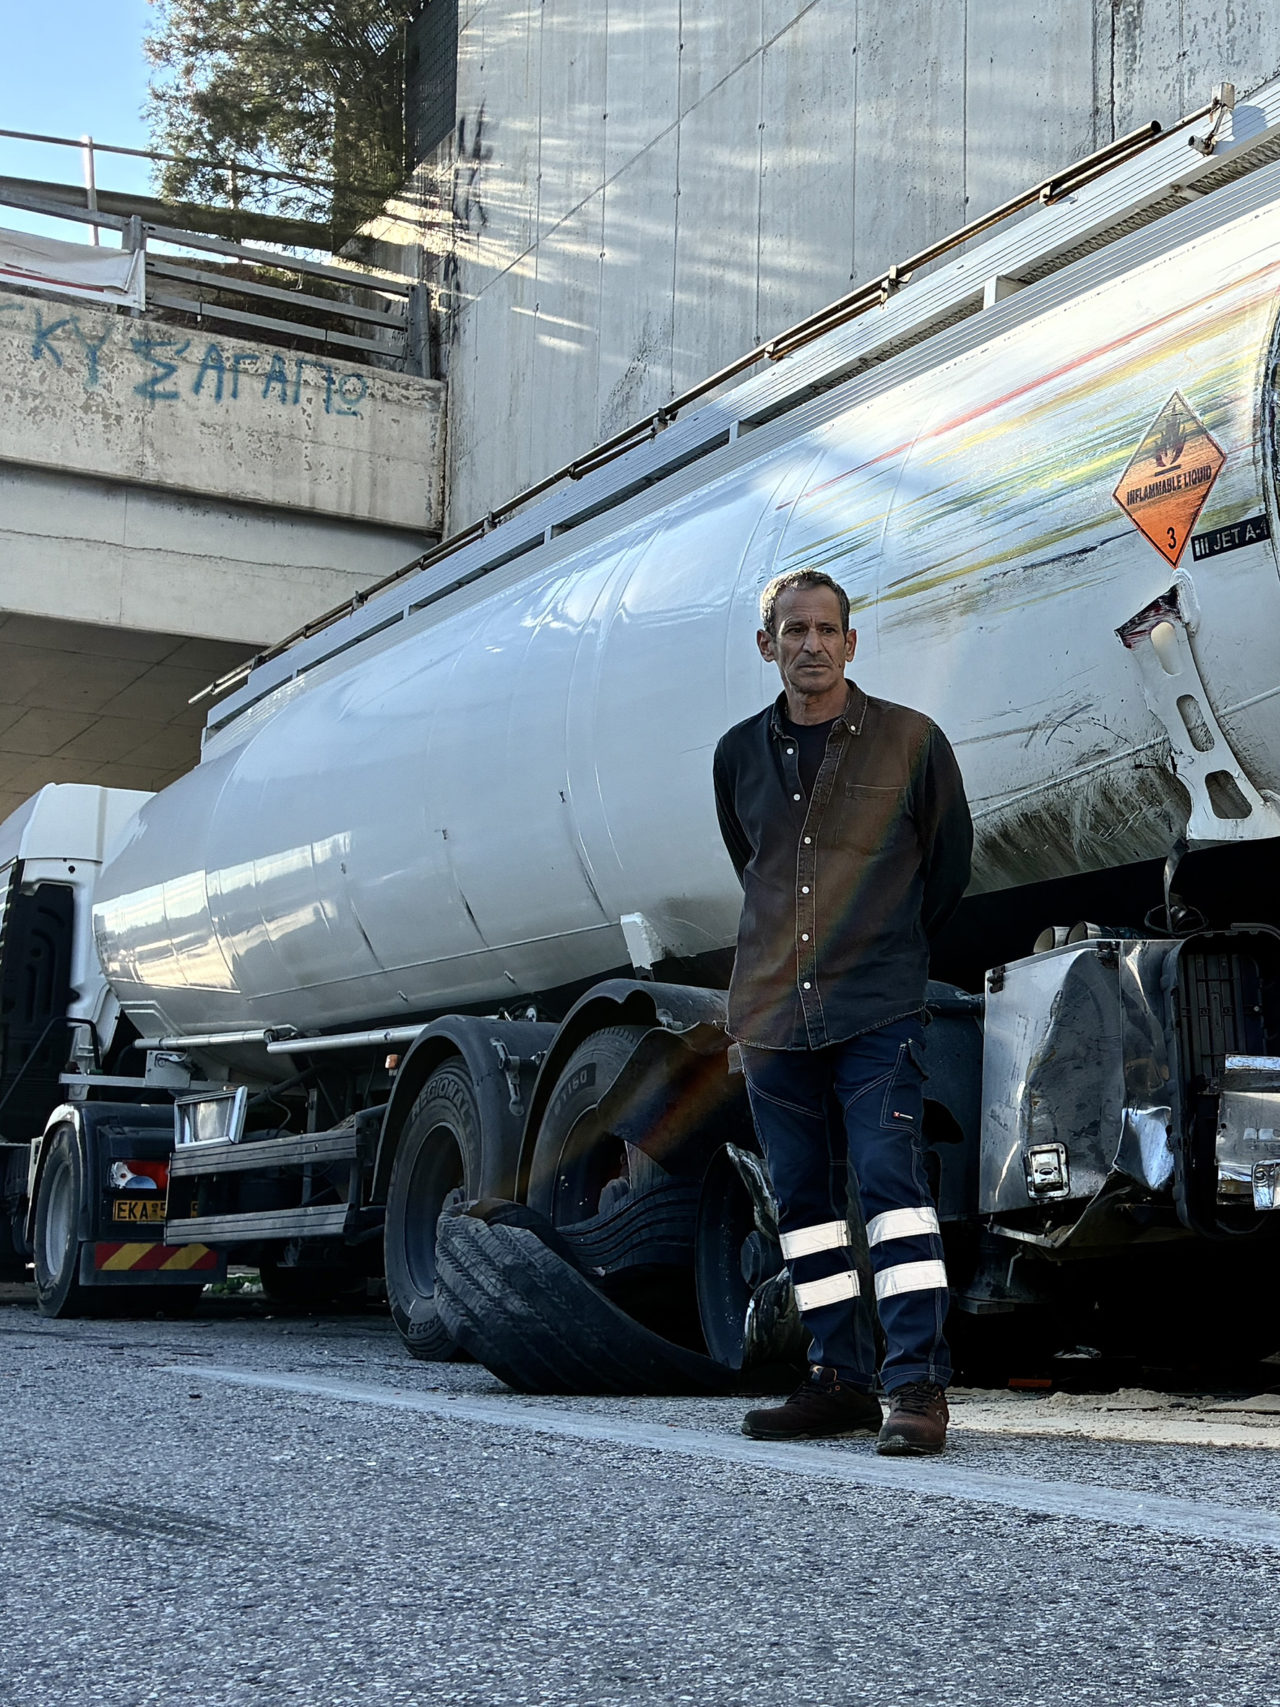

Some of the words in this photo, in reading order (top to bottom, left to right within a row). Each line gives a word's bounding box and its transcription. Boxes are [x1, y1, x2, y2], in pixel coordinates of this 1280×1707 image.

[1127, 474, 1182, 506] INFLAMMABLE
[1184, 465, 1212, 488] LIQUID
[1167, 526, 1177, 550] 3
[1213, 527, 1241, 551] JET
[1245, 518, 1269, 542] A-1
